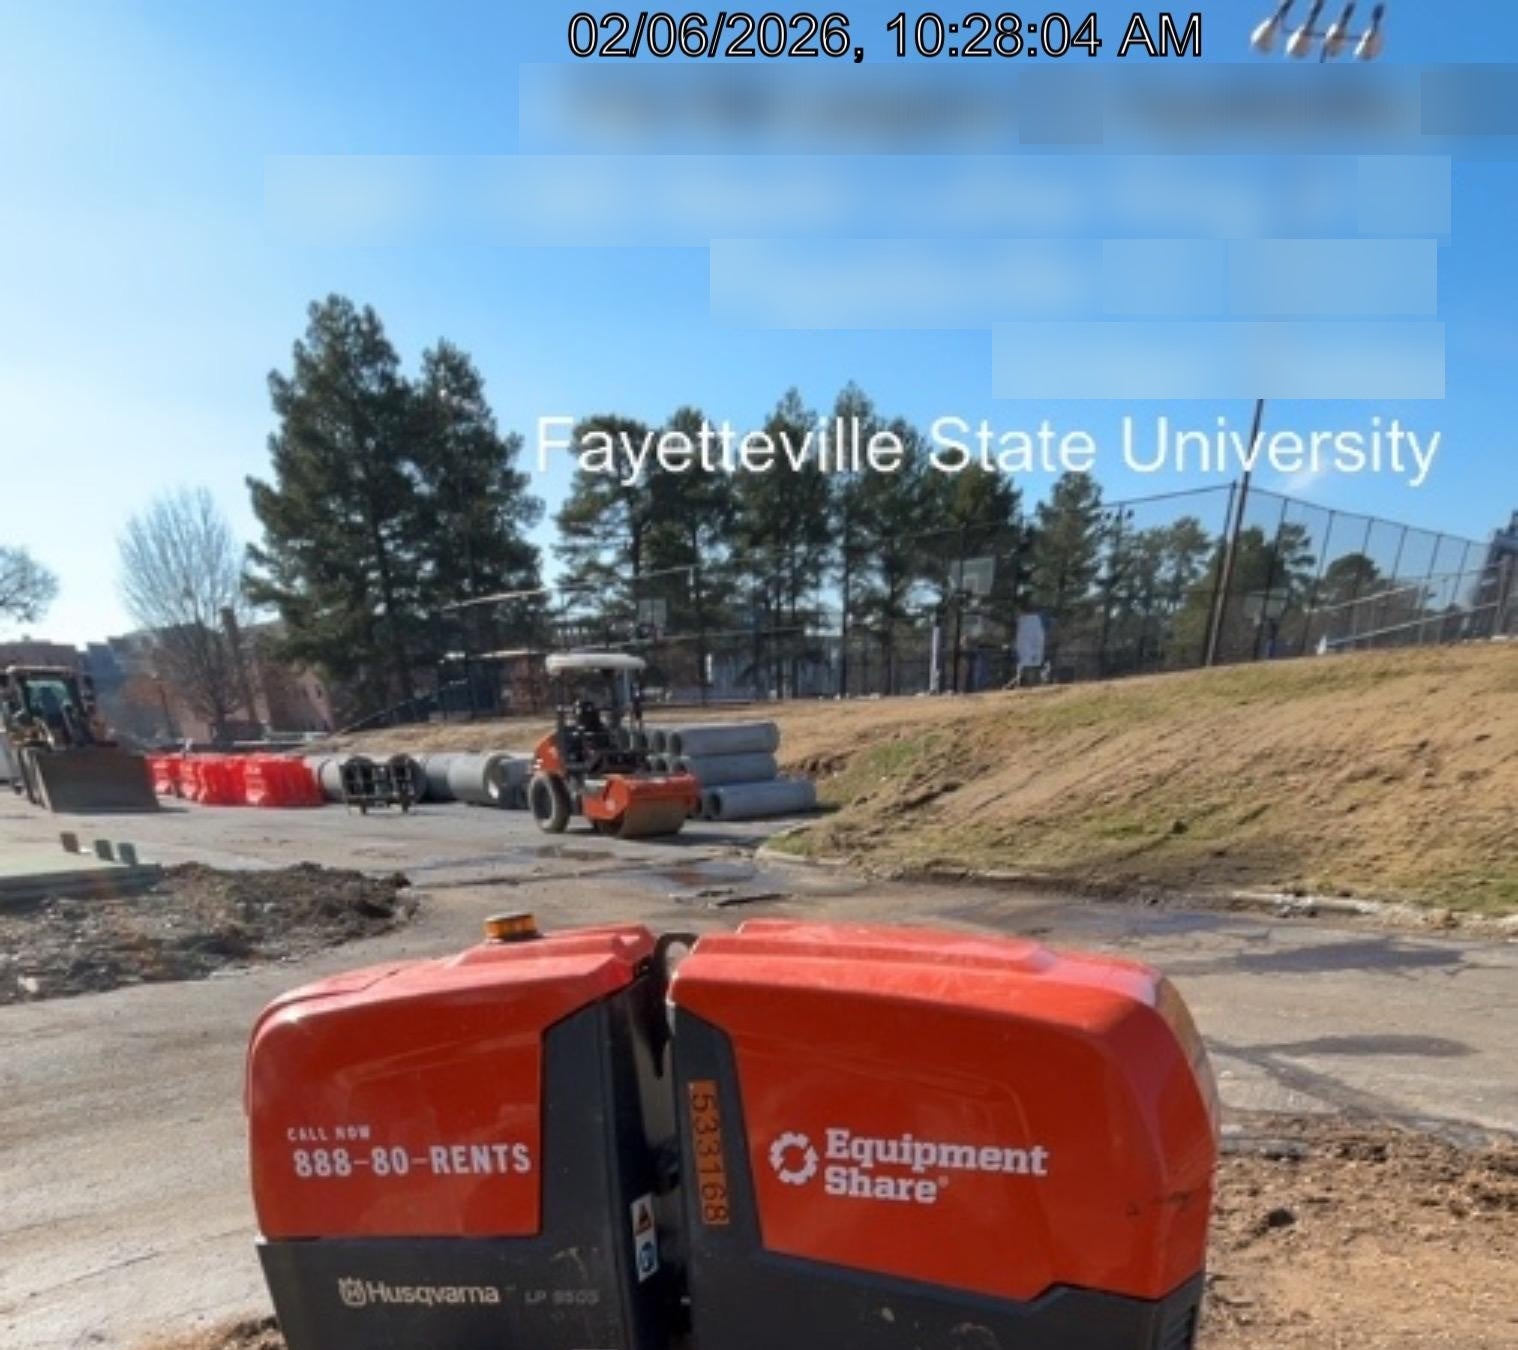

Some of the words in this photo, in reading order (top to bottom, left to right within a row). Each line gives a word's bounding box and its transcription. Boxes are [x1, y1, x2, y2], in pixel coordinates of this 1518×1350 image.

[287, 1128, 328, 1141] CALL
[335, 1125, 370, 1140] NOW
[293, 1143, 532, 1177] 888-80-RENTS
[693, 1093, 729, 1221] 533168
[825, 1127, 1048, 1177] Equipment
[365, 1279, 500, 1307] Husqvarna
